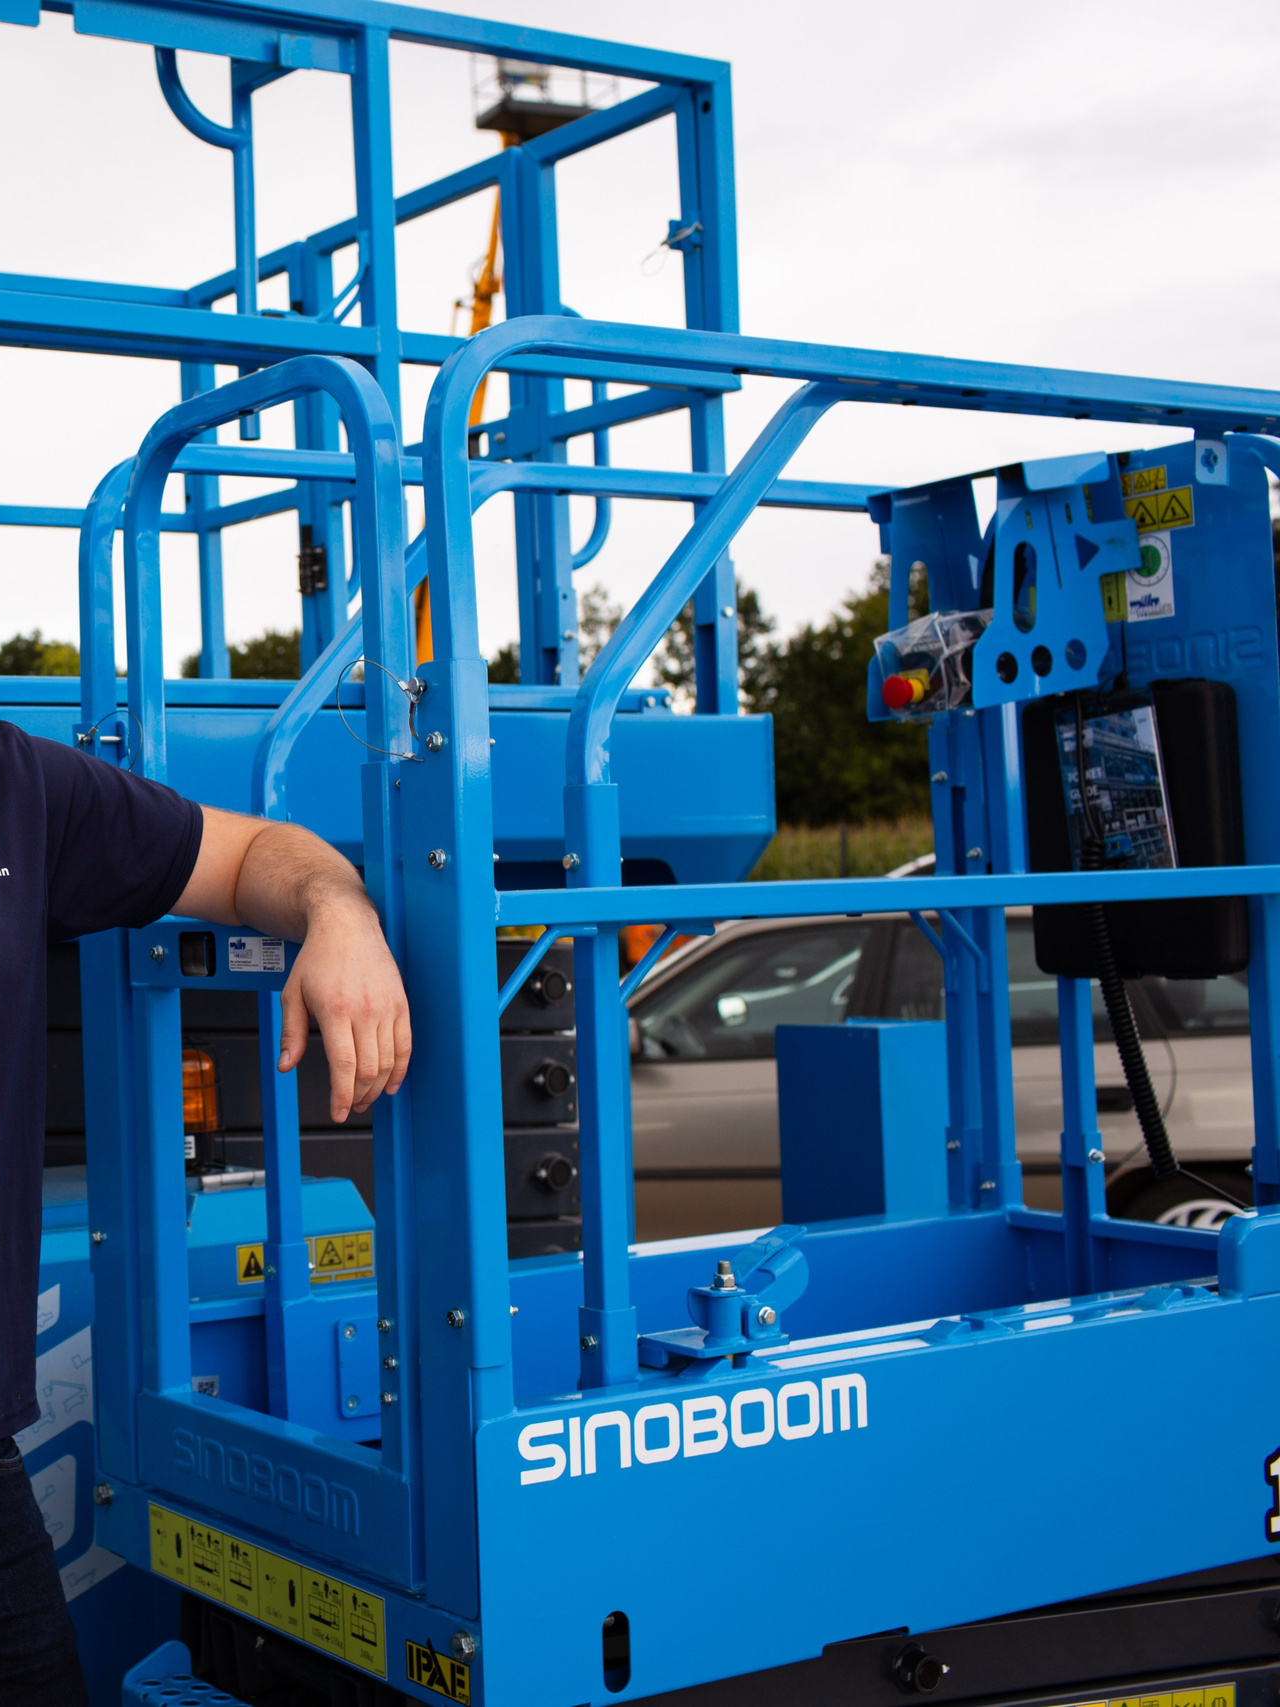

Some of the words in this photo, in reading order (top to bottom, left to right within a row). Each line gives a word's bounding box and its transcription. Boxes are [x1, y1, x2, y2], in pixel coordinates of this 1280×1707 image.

[174, 1427, 360, 1539] SINOBOOM
[518, 1372, 868, 1486] SINOBOOM
[407, 1637, 466, 1697] IPAF
